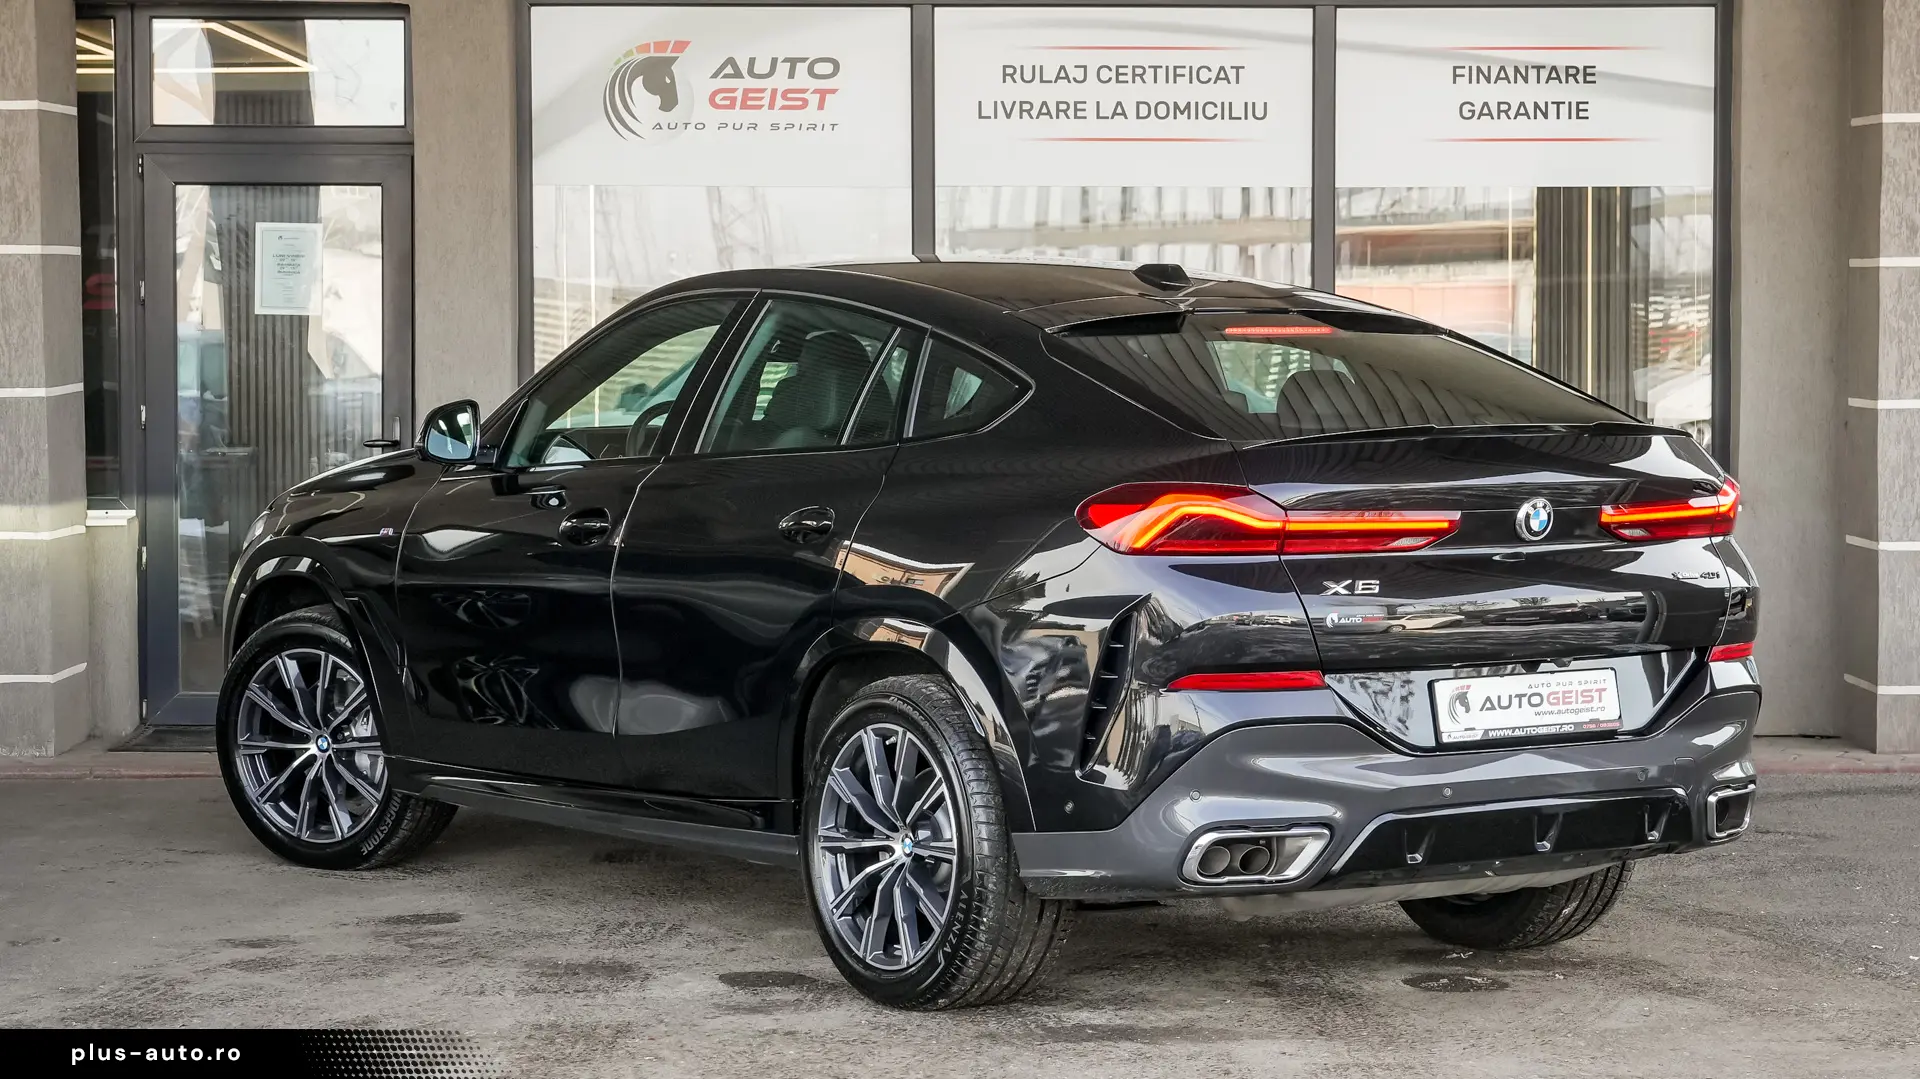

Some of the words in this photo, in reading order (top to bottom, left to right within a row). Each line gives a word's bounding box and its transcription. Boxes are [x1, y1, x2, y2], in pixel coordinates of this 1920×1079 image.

[709, 56, 841, 80] AUTO
[1002, 64, 1088, 84] RULAJ
[1096, 64, 1245, 85] CERTIFICAT
[1452, 65, 1597, 85] FINANTARE
[708, 87, 840, 111] GEIST
[977, 100, 1088, 120] LIVRARE
[1095, 100, 1129, 120] LA
[1135, 100, 1268, 121] DOMICILIU
[1458, 101, 1590, 120] GARANTIE
[652, 122, 706, 131] AUTO
[717, 122, 758, 131] PUR
[770, 122, 839, 131] SPIRIT
[1320, 579, 1380, 596] X6
[1578, 678, 1607, 686] SPIRIT
[1534, 705, 1606, 716] www.autogeist.ro
[1488, 724, 1575, 737] WWW.AUTOGEIST.RO
[943, 889, 968, 954] ALENZA
